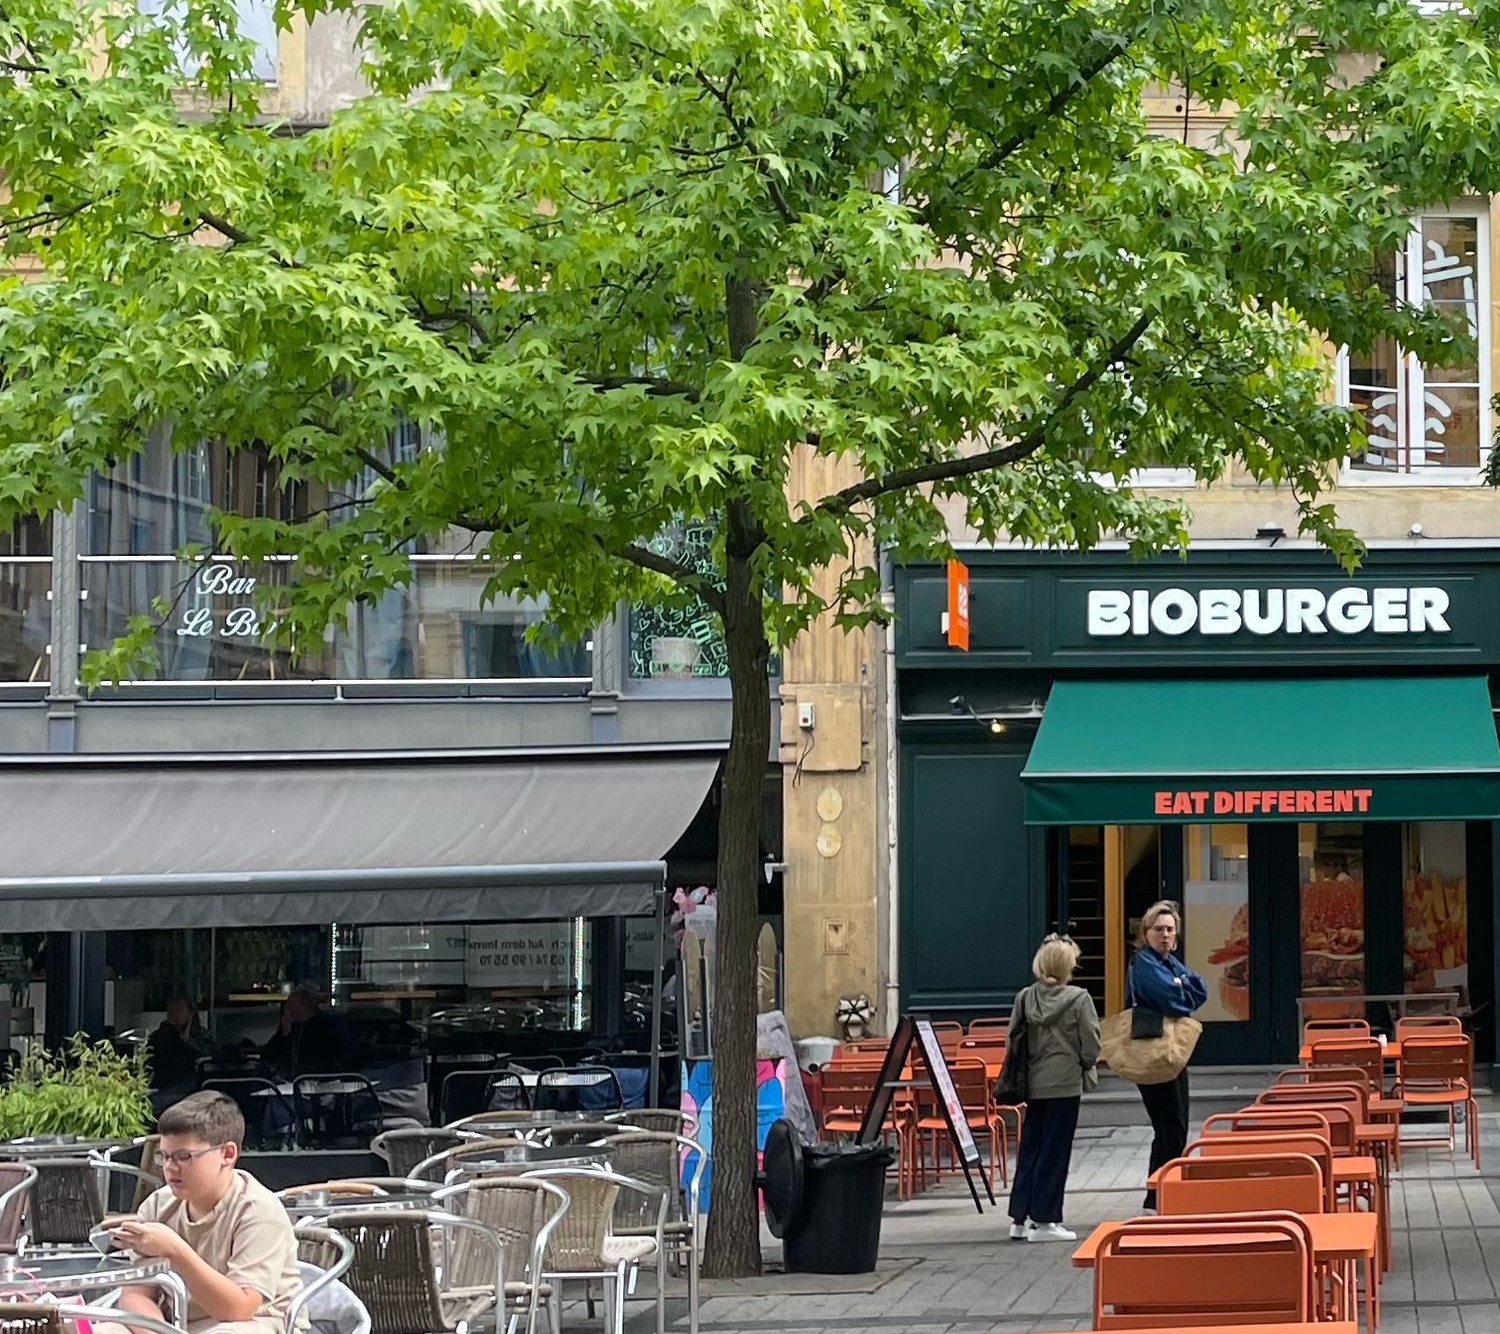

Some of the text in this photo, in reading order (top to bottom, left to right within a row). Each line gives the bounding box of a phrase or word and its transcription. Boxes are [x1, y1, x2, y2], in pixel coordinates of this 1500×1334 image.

[196, 564, 256, 595] Bar
[177, 607, 213, 636] Le
[1088, 587, 1451, 635] BIOBURGER
[1155, 789, 1373, 814] EAT DIFFERENT
